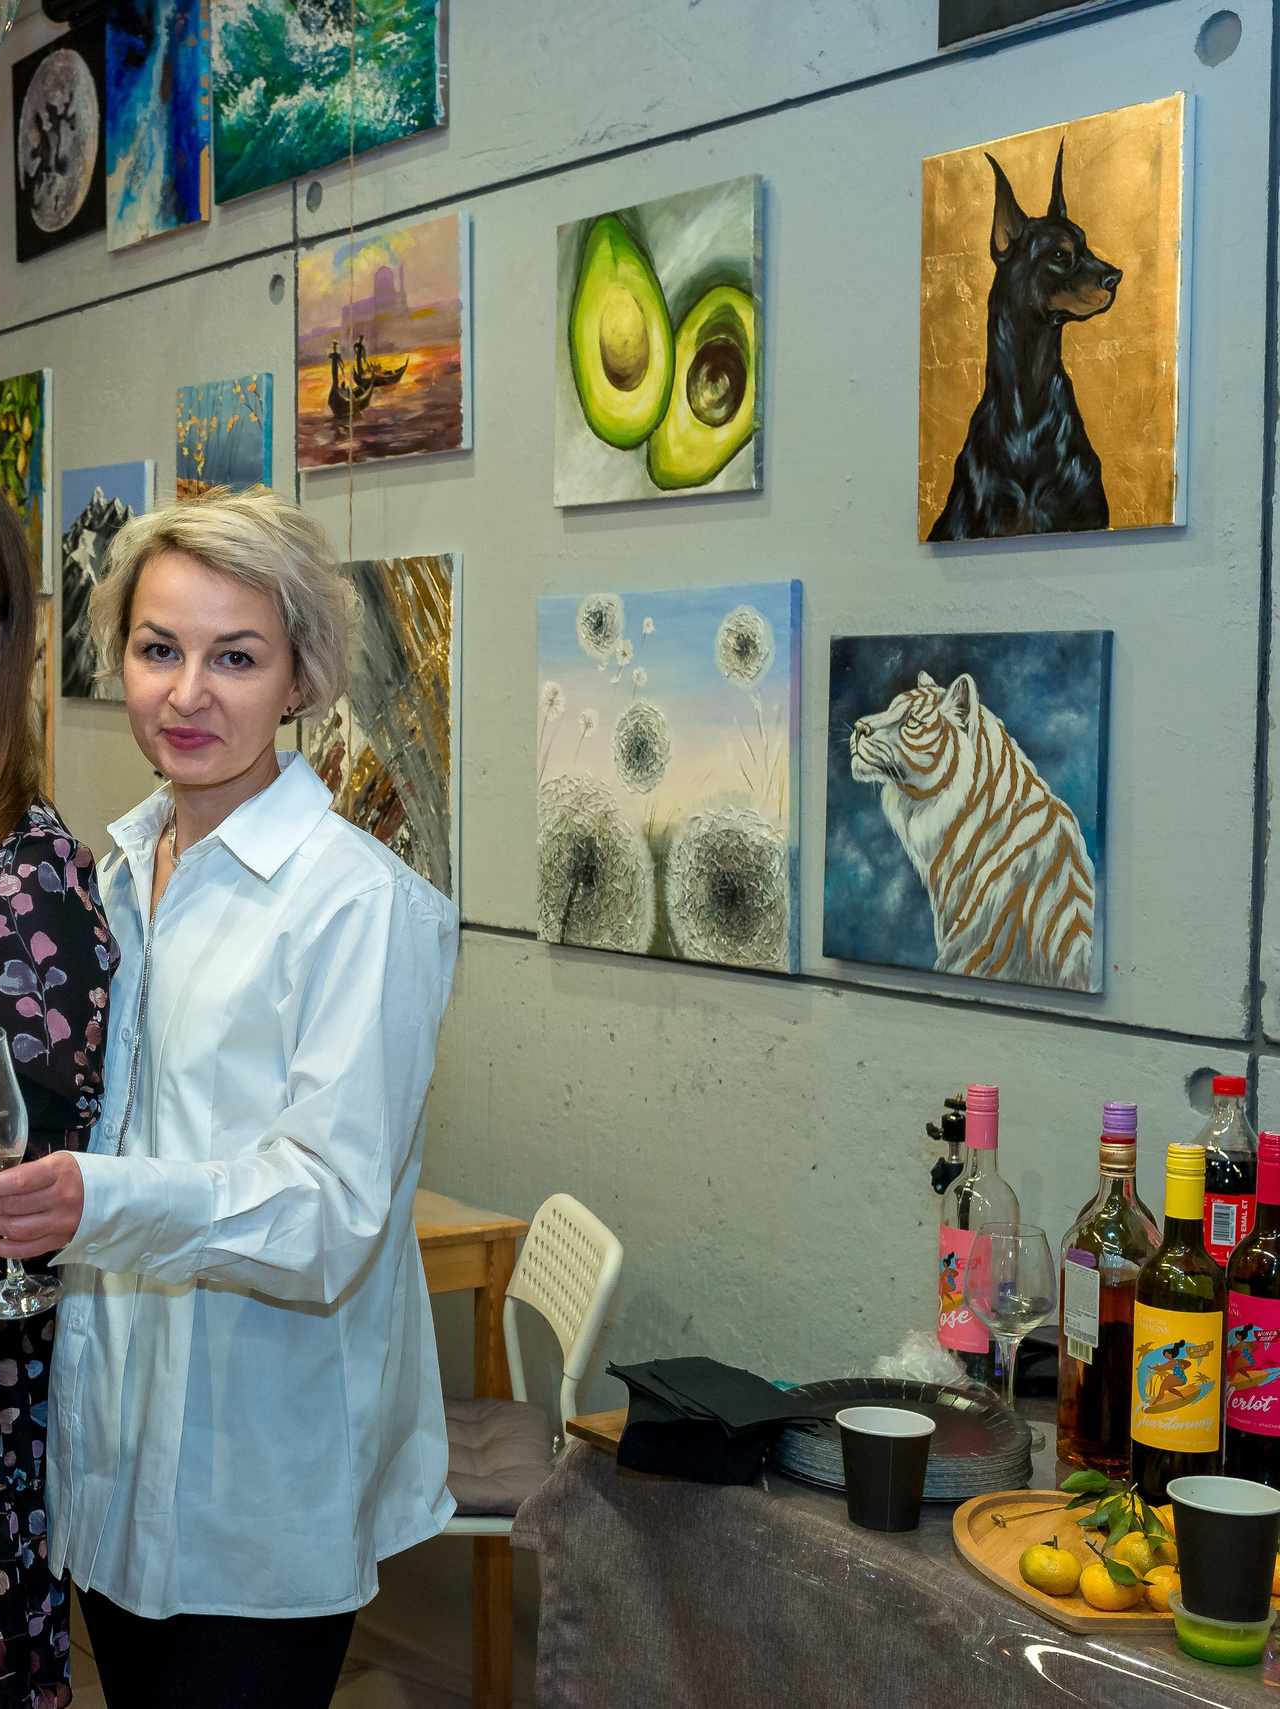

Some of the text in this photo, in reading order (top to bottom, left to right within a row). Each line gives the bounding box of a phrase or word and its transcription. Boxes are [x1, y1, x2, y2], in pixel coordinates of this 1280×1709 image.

[1241, 1199, 1249, 1210] ET
[1240, 1211, 1248, 1232] EMAL
[1133, 1401, 1214, 1432] Chardonnay
